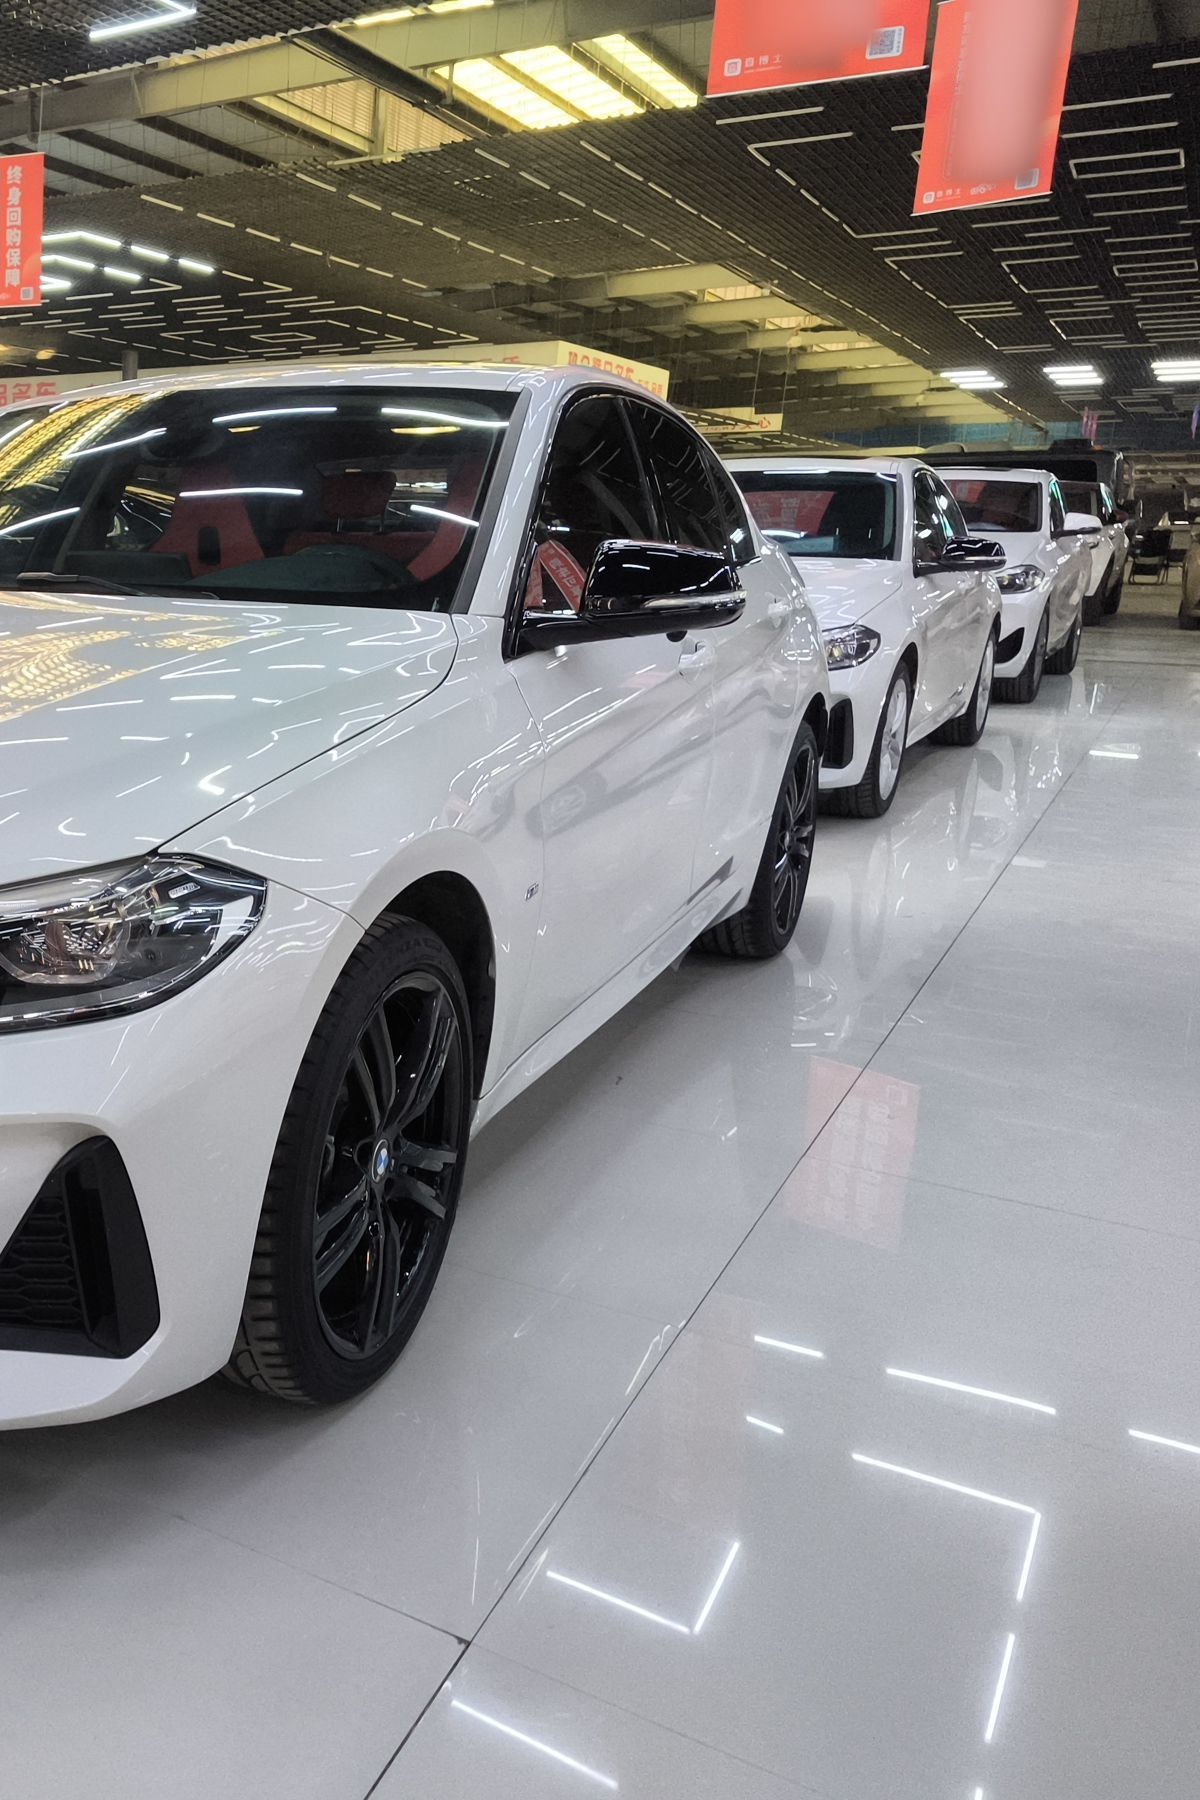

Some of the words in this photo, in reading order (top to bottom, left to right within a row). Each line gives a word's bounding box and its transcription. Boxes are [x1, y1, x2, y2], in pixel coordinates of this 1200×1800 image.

[4, 165, 23, 288] 终身回购保障
